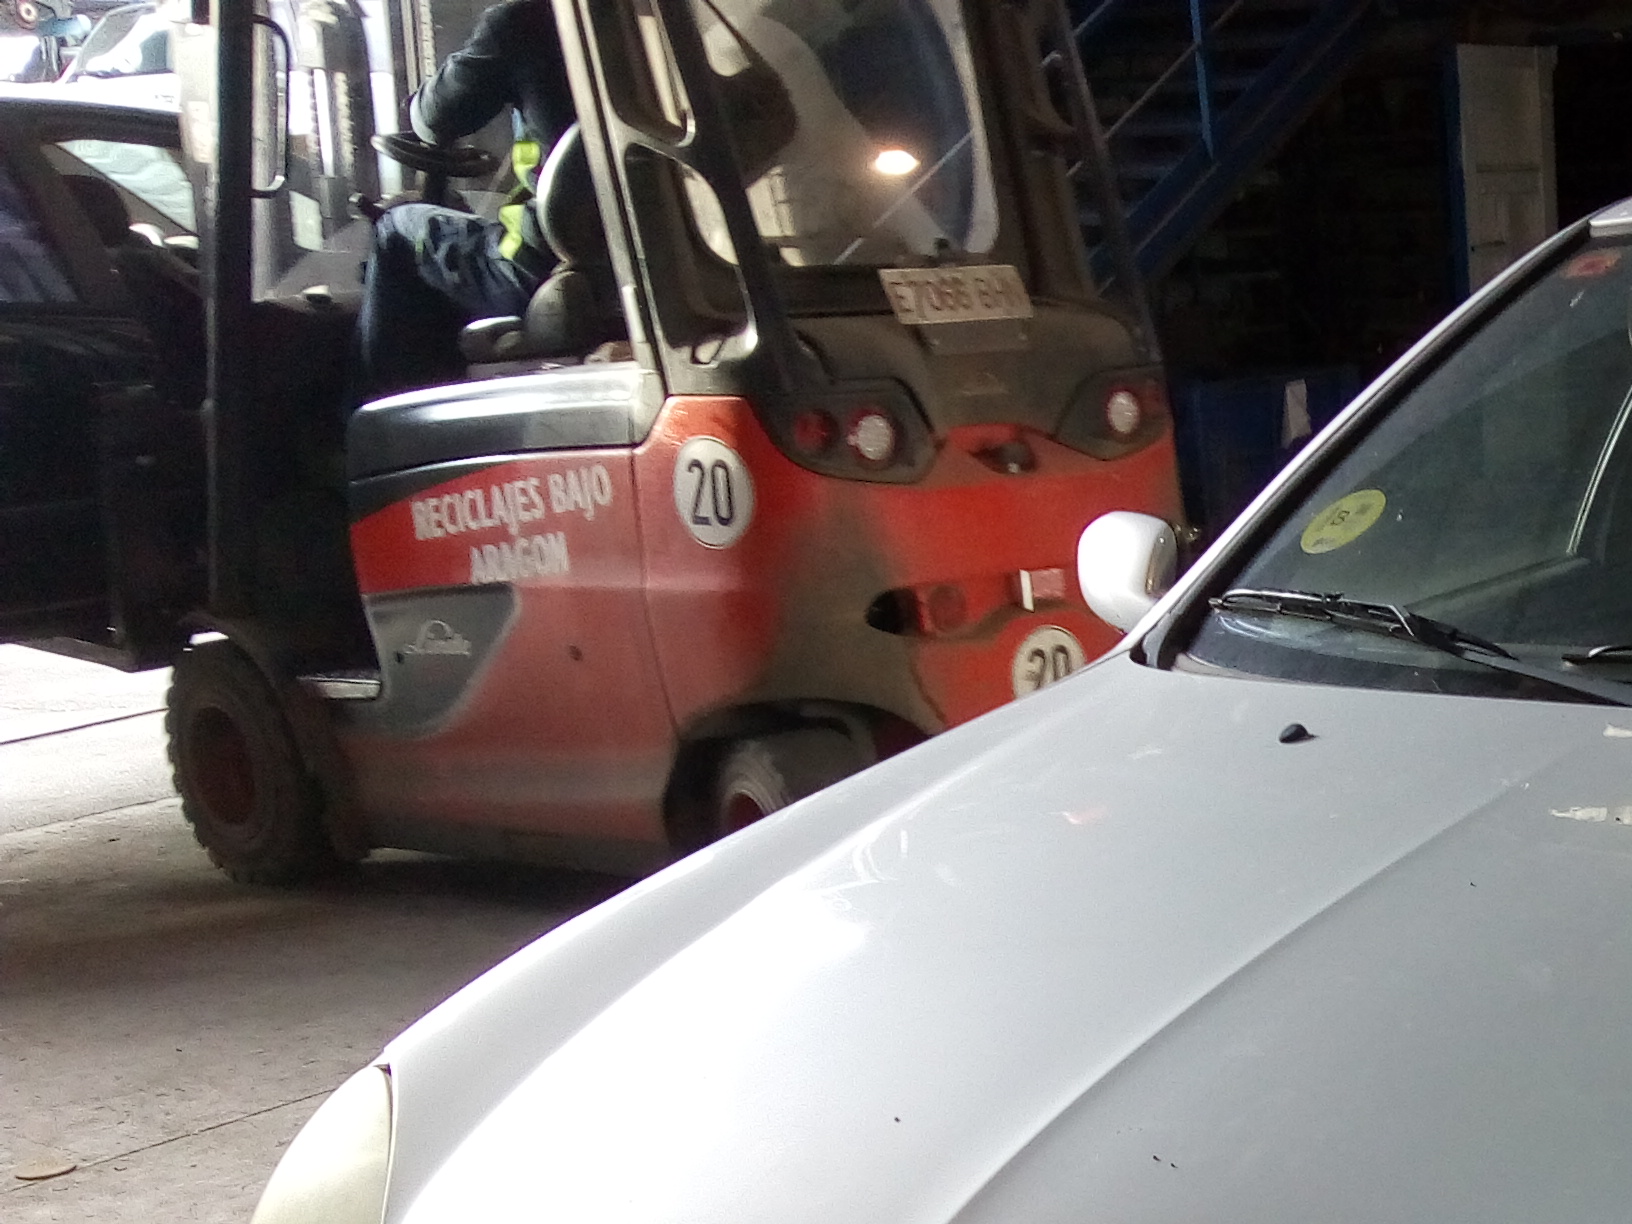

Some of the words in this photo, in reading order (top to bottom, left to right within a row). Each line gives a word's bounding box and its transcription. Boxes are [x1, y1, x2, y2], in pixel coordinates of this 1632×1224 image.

[411, 477, 546, 541] RECICLAJES
[547, 464, 613, 521] BAJO
[687, 459, 733, 526] 20
[1027, 644, 1074, 690] 20
